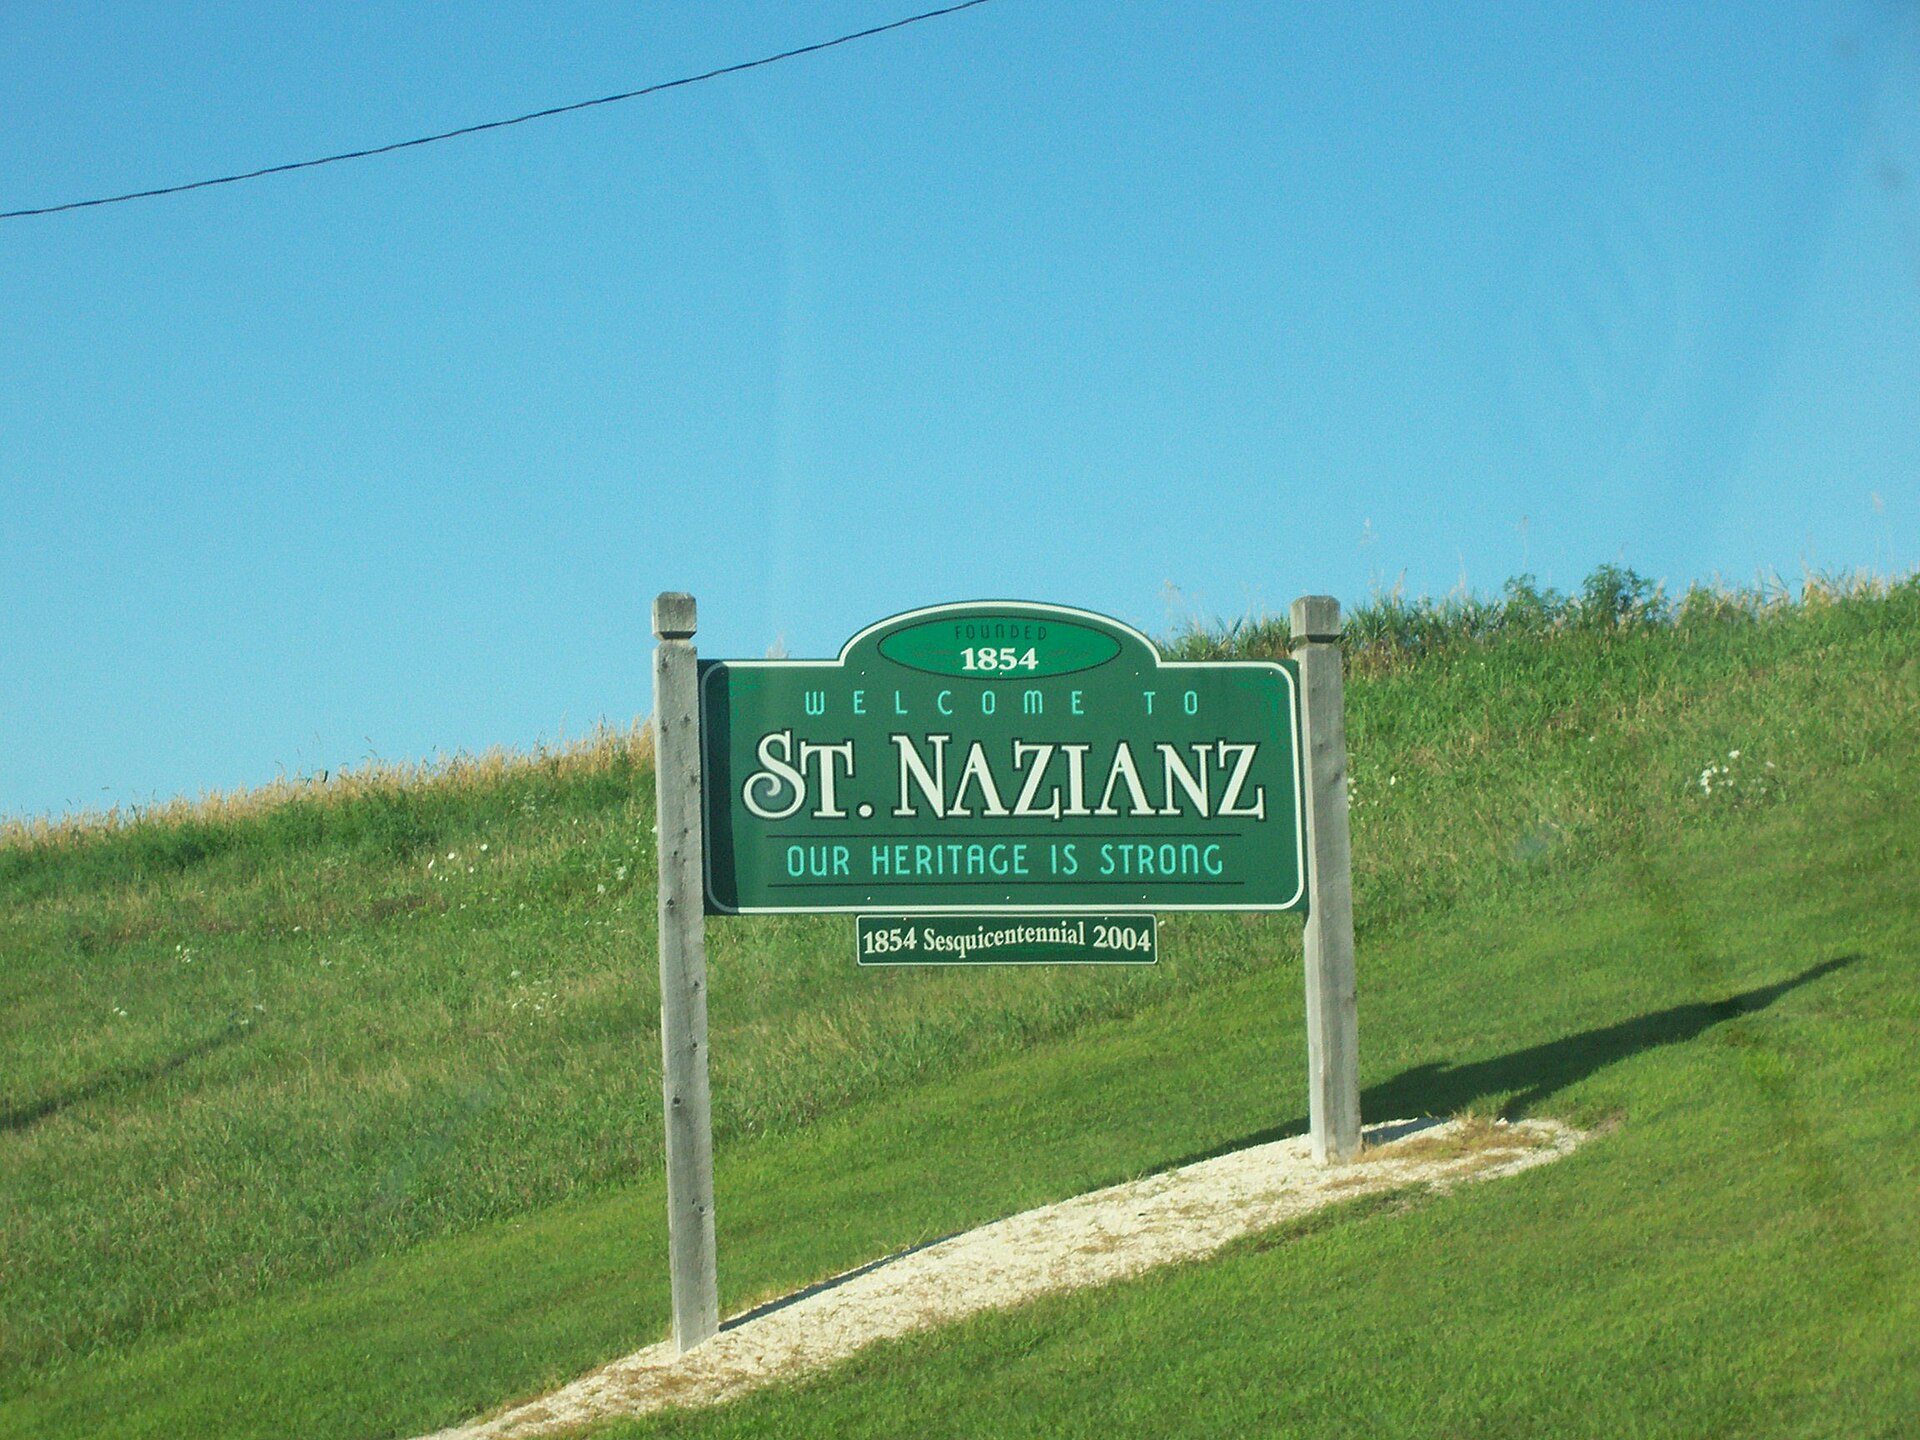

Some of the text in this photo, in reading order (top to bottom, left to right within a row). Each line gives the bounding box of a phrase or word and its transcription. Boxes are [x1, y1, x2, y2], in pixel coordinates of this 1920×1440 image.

[955, 624, 1047, 641] FOUNDED
[960, 647, 1039, 671] 1854
[804, 690, 1198, 715] WELCOME TO
[742, 730, 1266, 821] ST. NAZIANZ
[786, 843, 1223, 877] OUR HERITAGE IS STRONG
[863, 921, 1152, 959] 1854 Sesquicentennial 2004
